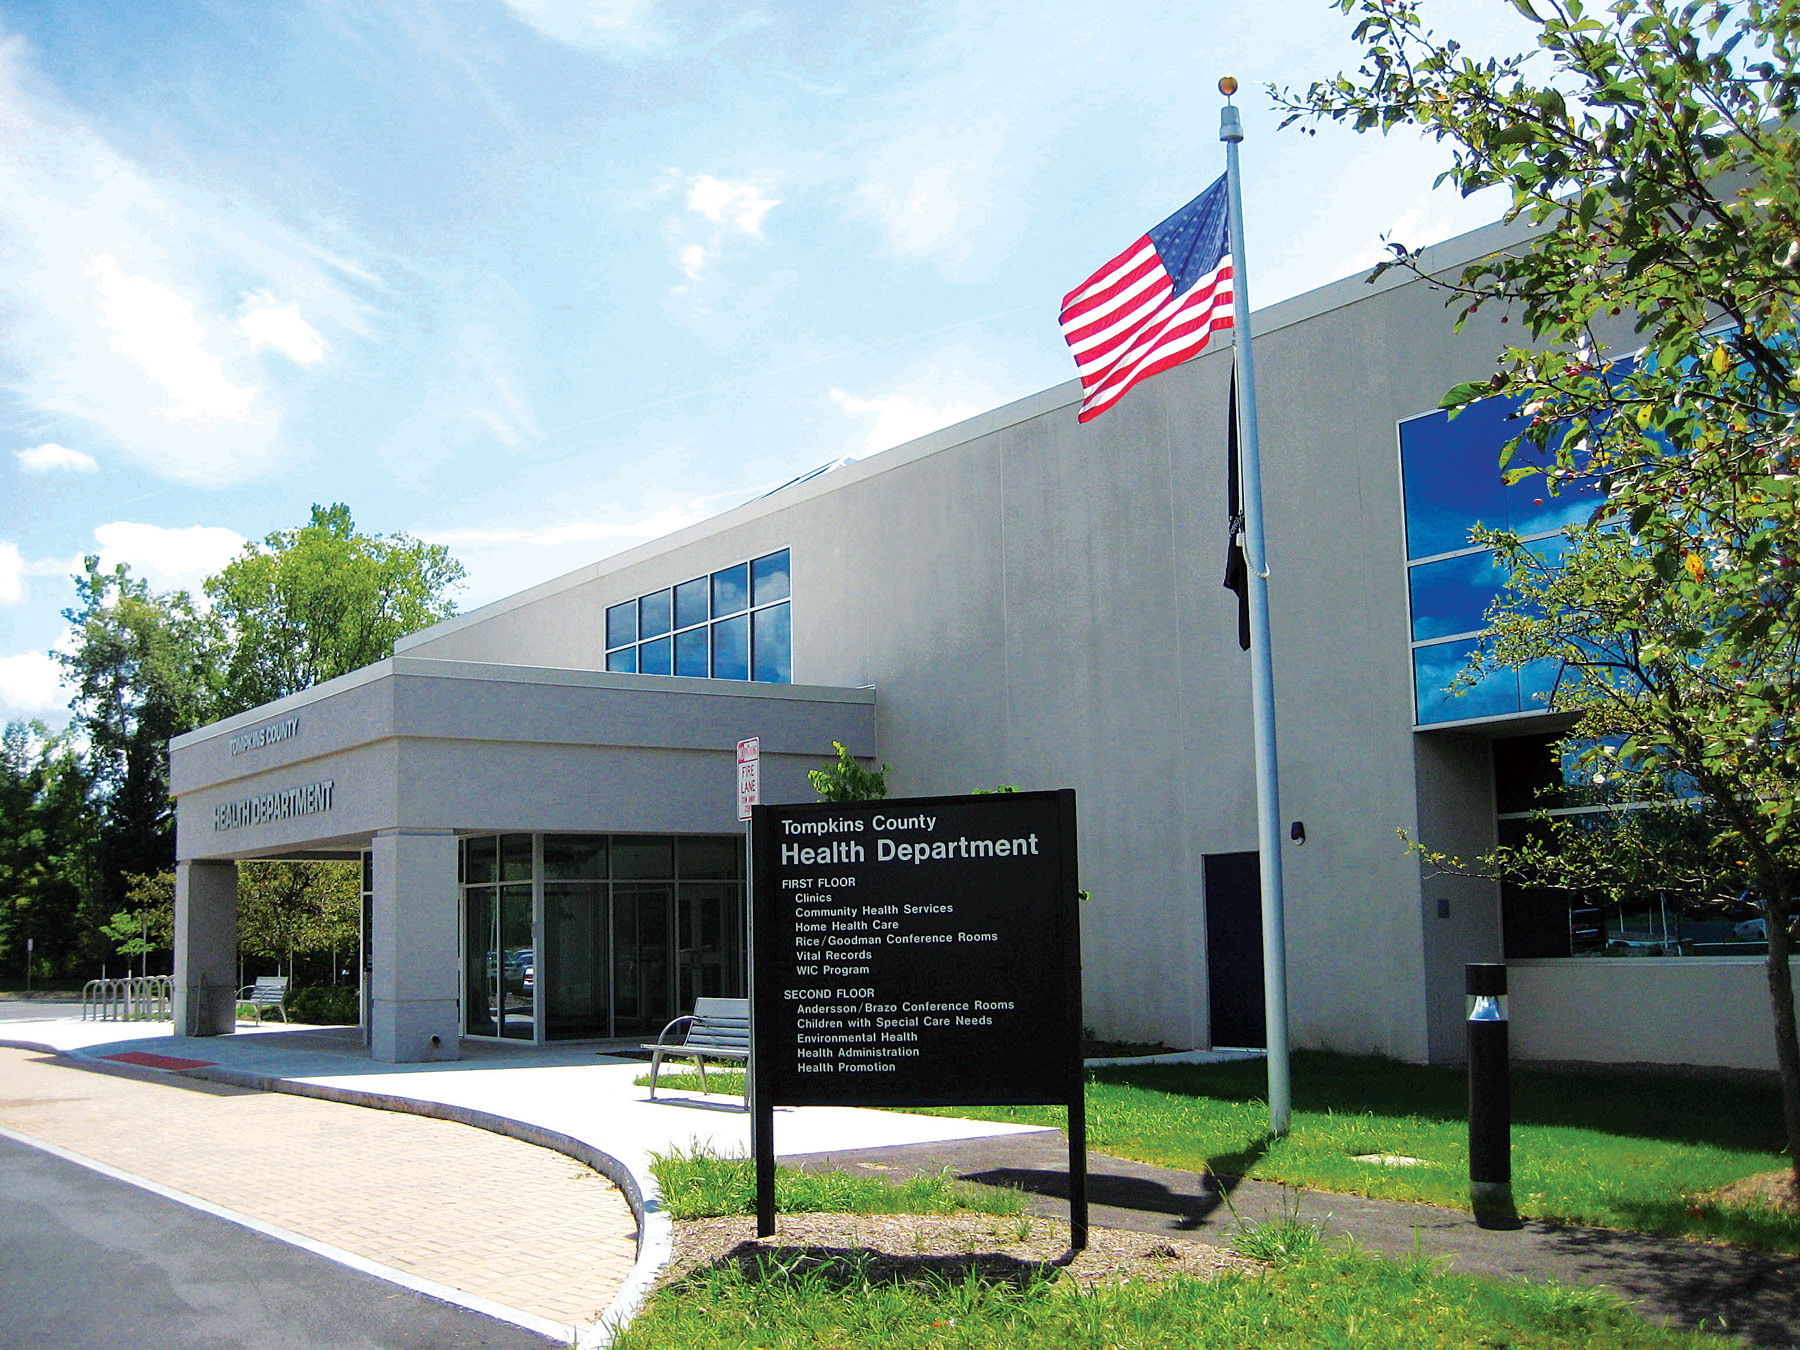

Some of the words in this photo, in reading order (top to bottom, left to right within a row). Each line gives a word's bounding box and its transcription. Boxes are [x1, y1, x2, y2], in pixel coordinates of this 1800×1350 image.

[229, 729, 265, 756] TOMPKINS
[266, 718, 299, 746] COUNTY
[741, 764, 755, 778] FIRE
[740, 779, 756, 794] LANE
[213, 800, 251, 832] HEALTH
[251, 779, 334, 826] DEPARTMENT
[781, 817, 865, 837] Tompkins
[872, 814, 937, 832] County
[781, 840, 865, 866] Health
[877, 833, 1039, 865] Department
[782, 878, 814, 890] FIRST
[817, 876, 856, 888] FLOOR
[795, 893, 833, 904] Clinics
[795, 906, 858, 918] Community
[862, 904, 899, 916] Health
[903, 903, 954, 915] Services
[795, 922, 827, 932] Home
[831, 920, 868, 931] Health
[872, 919, 899, 930] Care
[795, 935, 882, 947] Rice/Goodman
[886, 933, 953, 945] Conference
[957, 931, 998, 942] Rooms
[796, 950, 821, 961] Vital
[825, 949, 873, 961] Records
[796, 965, 819, 976] WIC
[823, 965, 870, 977] Program
[783, 988, 832, 1000] SECOND
[836, 987, 875, 999] FLOOR
[796, 1002, 898, 1014] Andersson/Brazo
[902, 1001, 969, 1012] Conference
[974, 1000, 1015, 1011] Rooms
[796, 1018, 843, 1029] Children
[847, 1017, 871, 1028] with
[876, 1016, 919, 1029] Special
[923, 1015, 951, 1027] Care
[955, 1014, 993, 1026] Needs
[797, 1032, 877, 1044] Environmental
[881, 1031, 918, 1042] Health
[797, 1047, 833, 1058] Health
[837, 1046, 920, 1058] Administration
[797, 1062, 834, 1073] Health
[838, 1061, 896, 1072] Promotion
